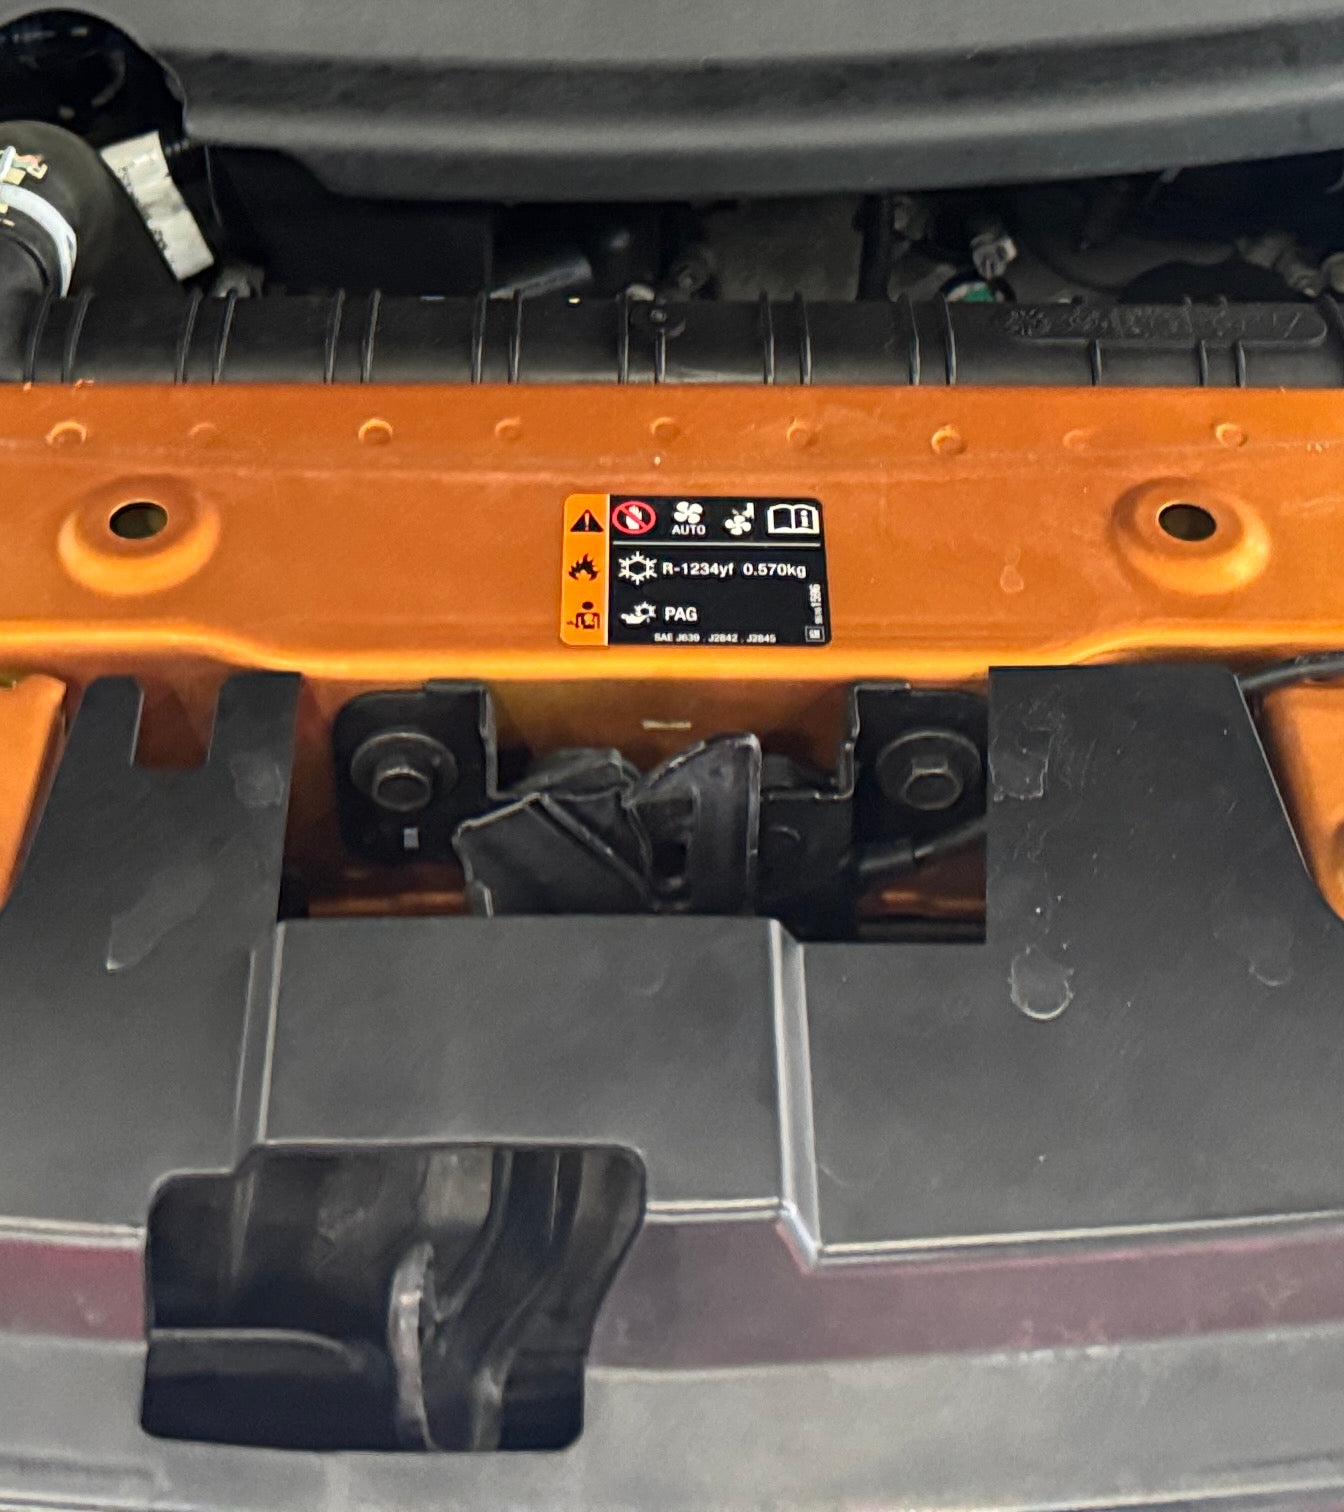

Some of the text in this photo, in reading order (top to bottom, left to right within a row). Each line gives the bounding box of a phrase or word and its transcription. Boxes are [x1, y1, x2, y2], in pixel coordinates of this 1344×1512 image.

[671, 524, 706, 536] AUTO
[662, 562, 807, 579] R-1234yf 0.570kg
[664, 607, 698, 622] PAG
